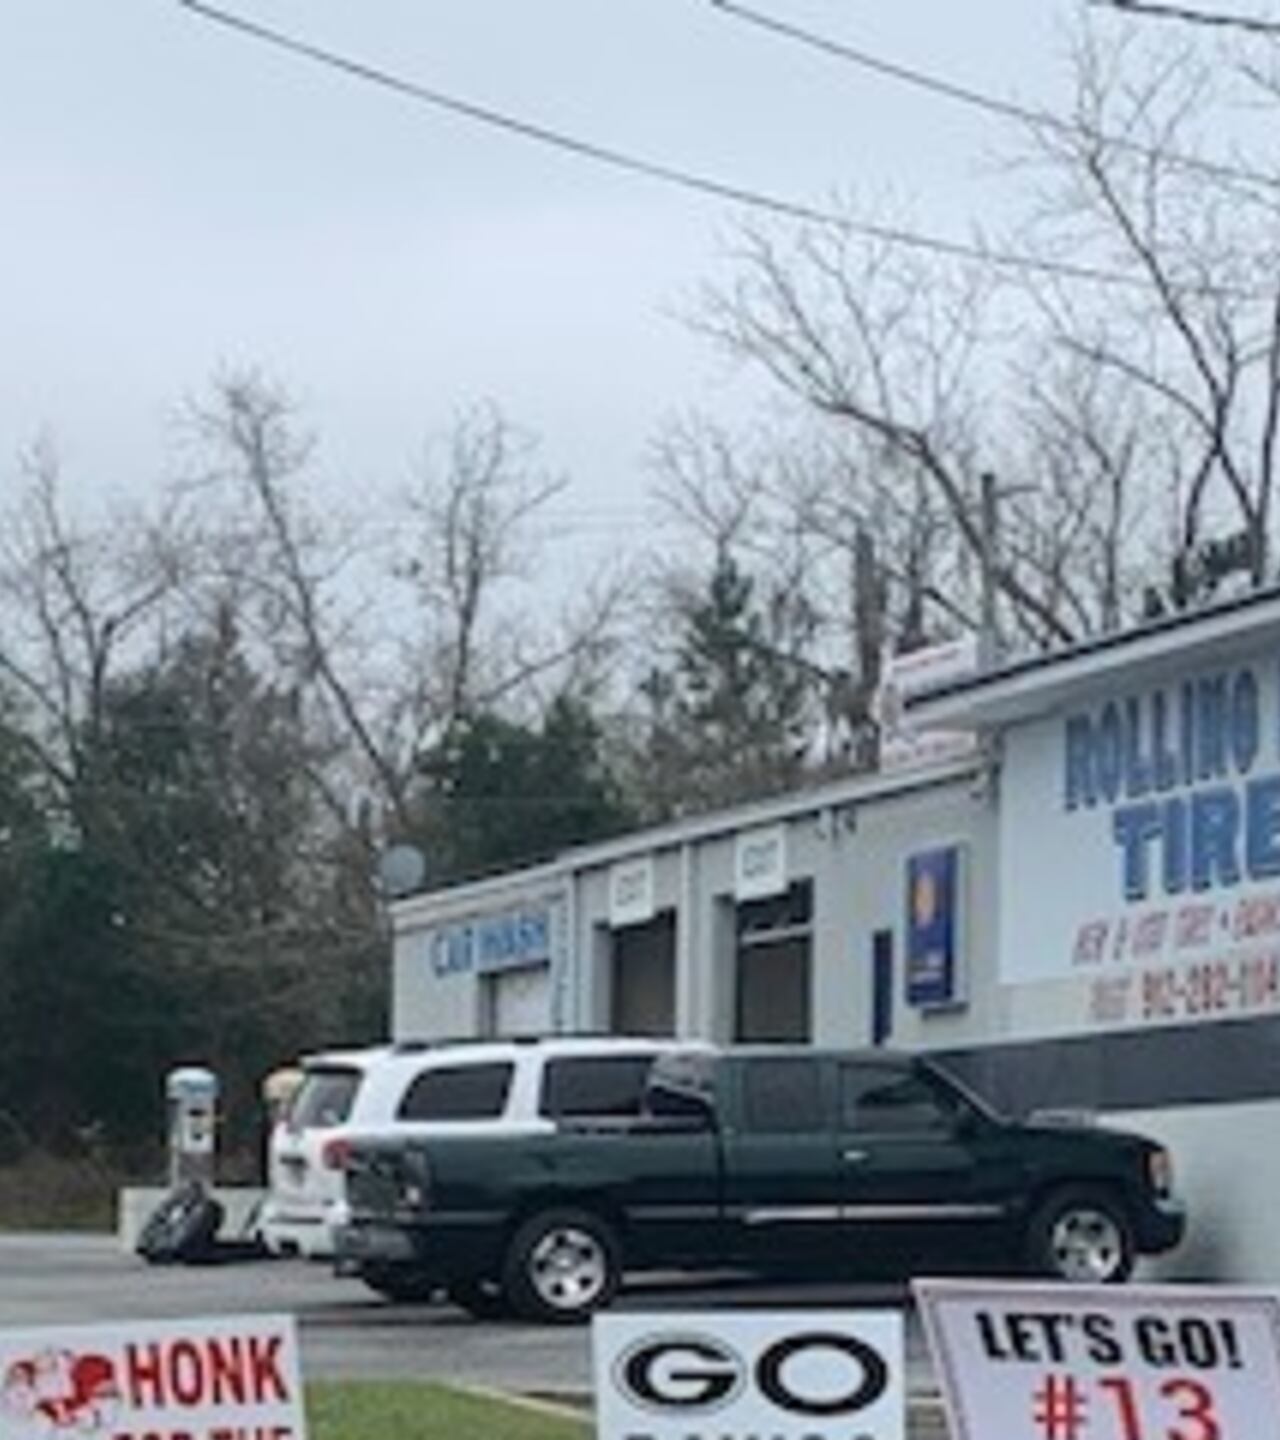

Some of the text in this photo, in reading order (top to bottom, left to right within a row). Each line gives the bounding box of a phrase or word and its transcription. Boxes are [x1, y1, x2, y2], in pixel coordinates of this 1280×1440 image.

[127, 1335, 288, 1408] HONK
[622, 1330, 890, 1418] GO
[977, 1311, 1242, 1370] LET'S GO!
